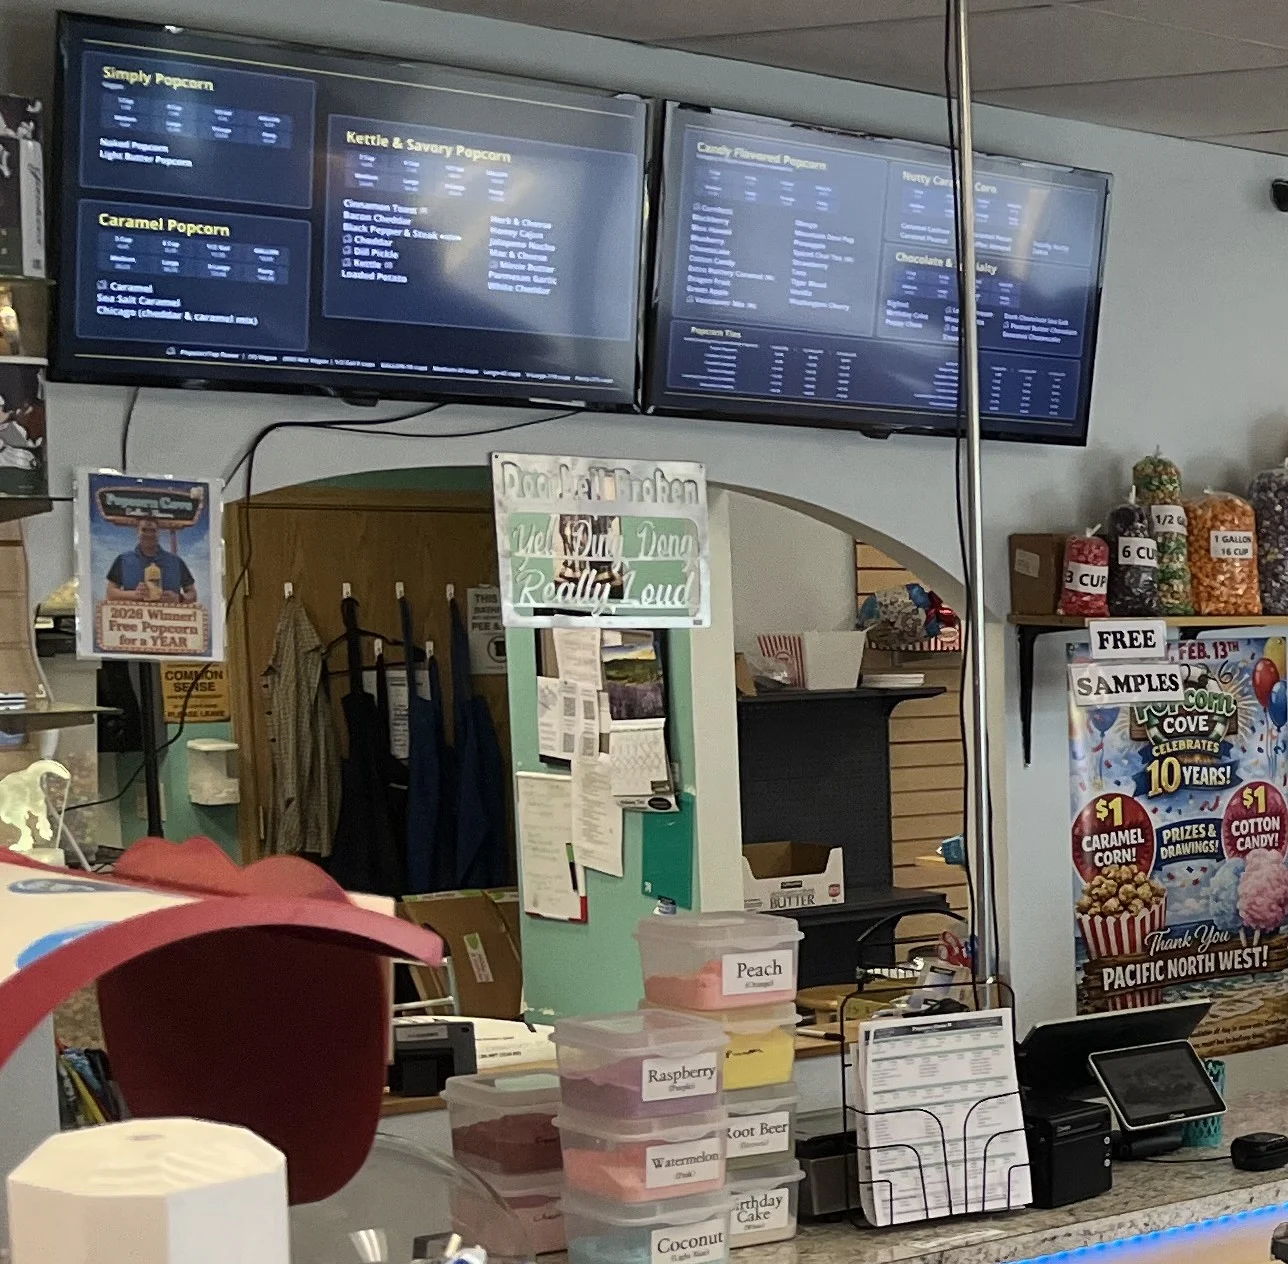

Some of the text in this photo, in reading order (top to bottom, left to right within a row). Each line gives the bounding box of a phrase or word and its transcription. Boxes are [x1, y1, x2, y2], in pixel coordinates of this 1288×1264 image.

[102, 66, 215, 92] Simply Popcorn
[346, 131, 512, 163] Kettle & Savory Popcorn
[99, 213, 231, 237] Caramel Popcorn
[1155, 514, 1174, 525] 1/2
[515, 568, 695, 618] Really Loud
[147, 608, 197, 622] Winner!
[109, 620, 198, 636] Free Popcorn
[119, 634, 138, 646] for
[150, 635, 188, 648] YEAR
[1097, 630, 1156, 650] FREE
[1179, 642, 1210, 660] FEB.
[165, 669, 223, 682] COMMON
[1077, 673, 1180, 696] SAMPLES
[174, 681, 216, 693] SENSE
[1163, 715, 1209, 734] COVE
[1152, 740, 1219, 758] CELEBRATES
[1147, 757, 1231, 799] 10 YEARS!
[1243, 785, 1267, 813] $1
[1096, 797, 1123, 827] $1
[1162, 823, 1217, 844] PRIZES &
[1231, 816, 1281, 836] COTTON
[1081, 828, 1145, 852] CARAMEL
[1160, 840, 1219, 860] DRAWINGS!
[1236, 833, 1279, 852] CANDY!
[1094, 848, 1137, 867] CORN!
[769, 893, 816, 909] BUTTER
[1145, 924, 1232, 957] Thank You
[737, 959, 783, 979] Peach
[1103, 945, 1269, 992] PACIFIC NORTH WEST!
[648, 1064, 716, 1085] Raspberry
[651, 1151, 719, 1169] Watermelon
[737, 1210, 771, 1224] Cake
[657, 1231, 723, 1254] Coconut
